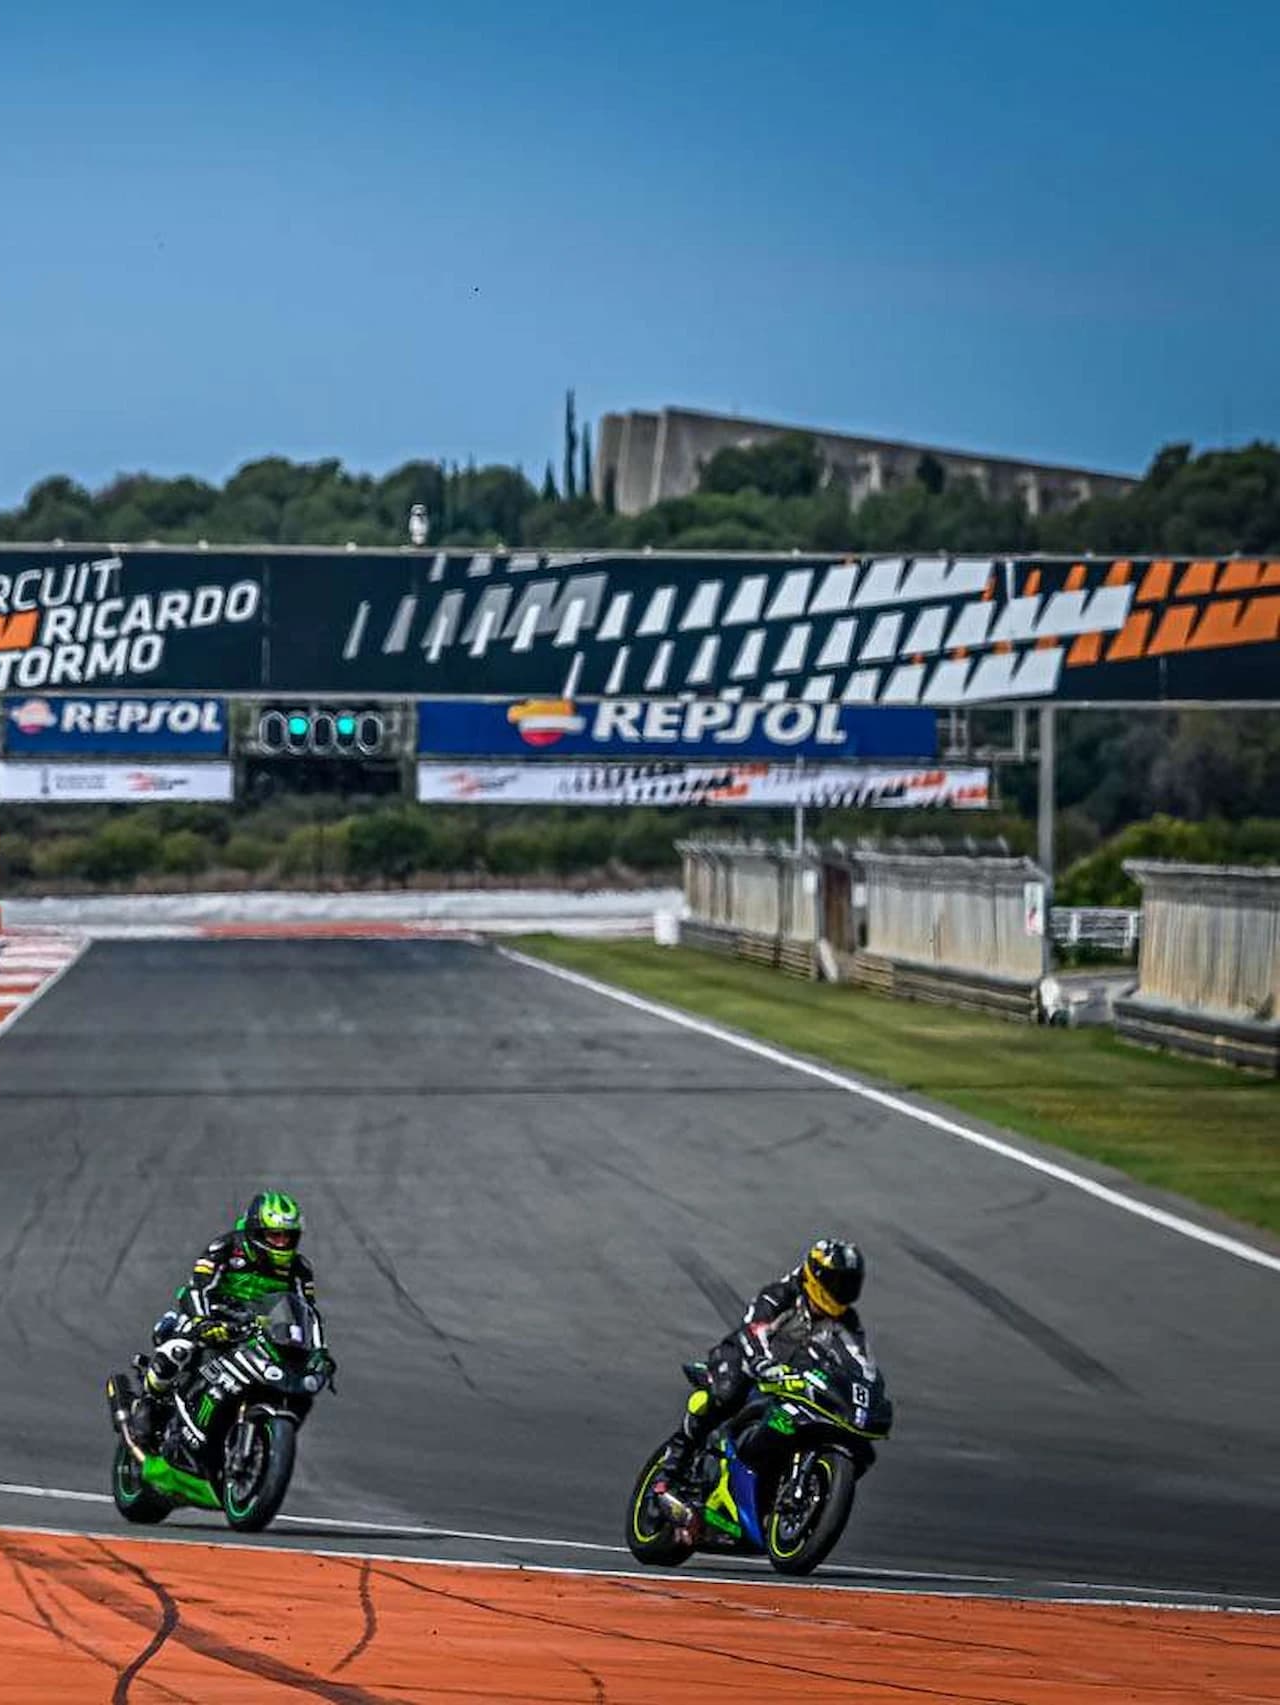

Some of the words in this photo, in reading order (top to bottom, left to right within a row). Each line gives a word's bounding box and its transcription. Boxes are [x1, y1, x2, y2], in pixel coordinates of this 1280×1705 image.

[41, 581, 259, 645] RICARDO
[60, 700, 221, 734] REPSOL
[591, 700, 848, 744] REPSOL
